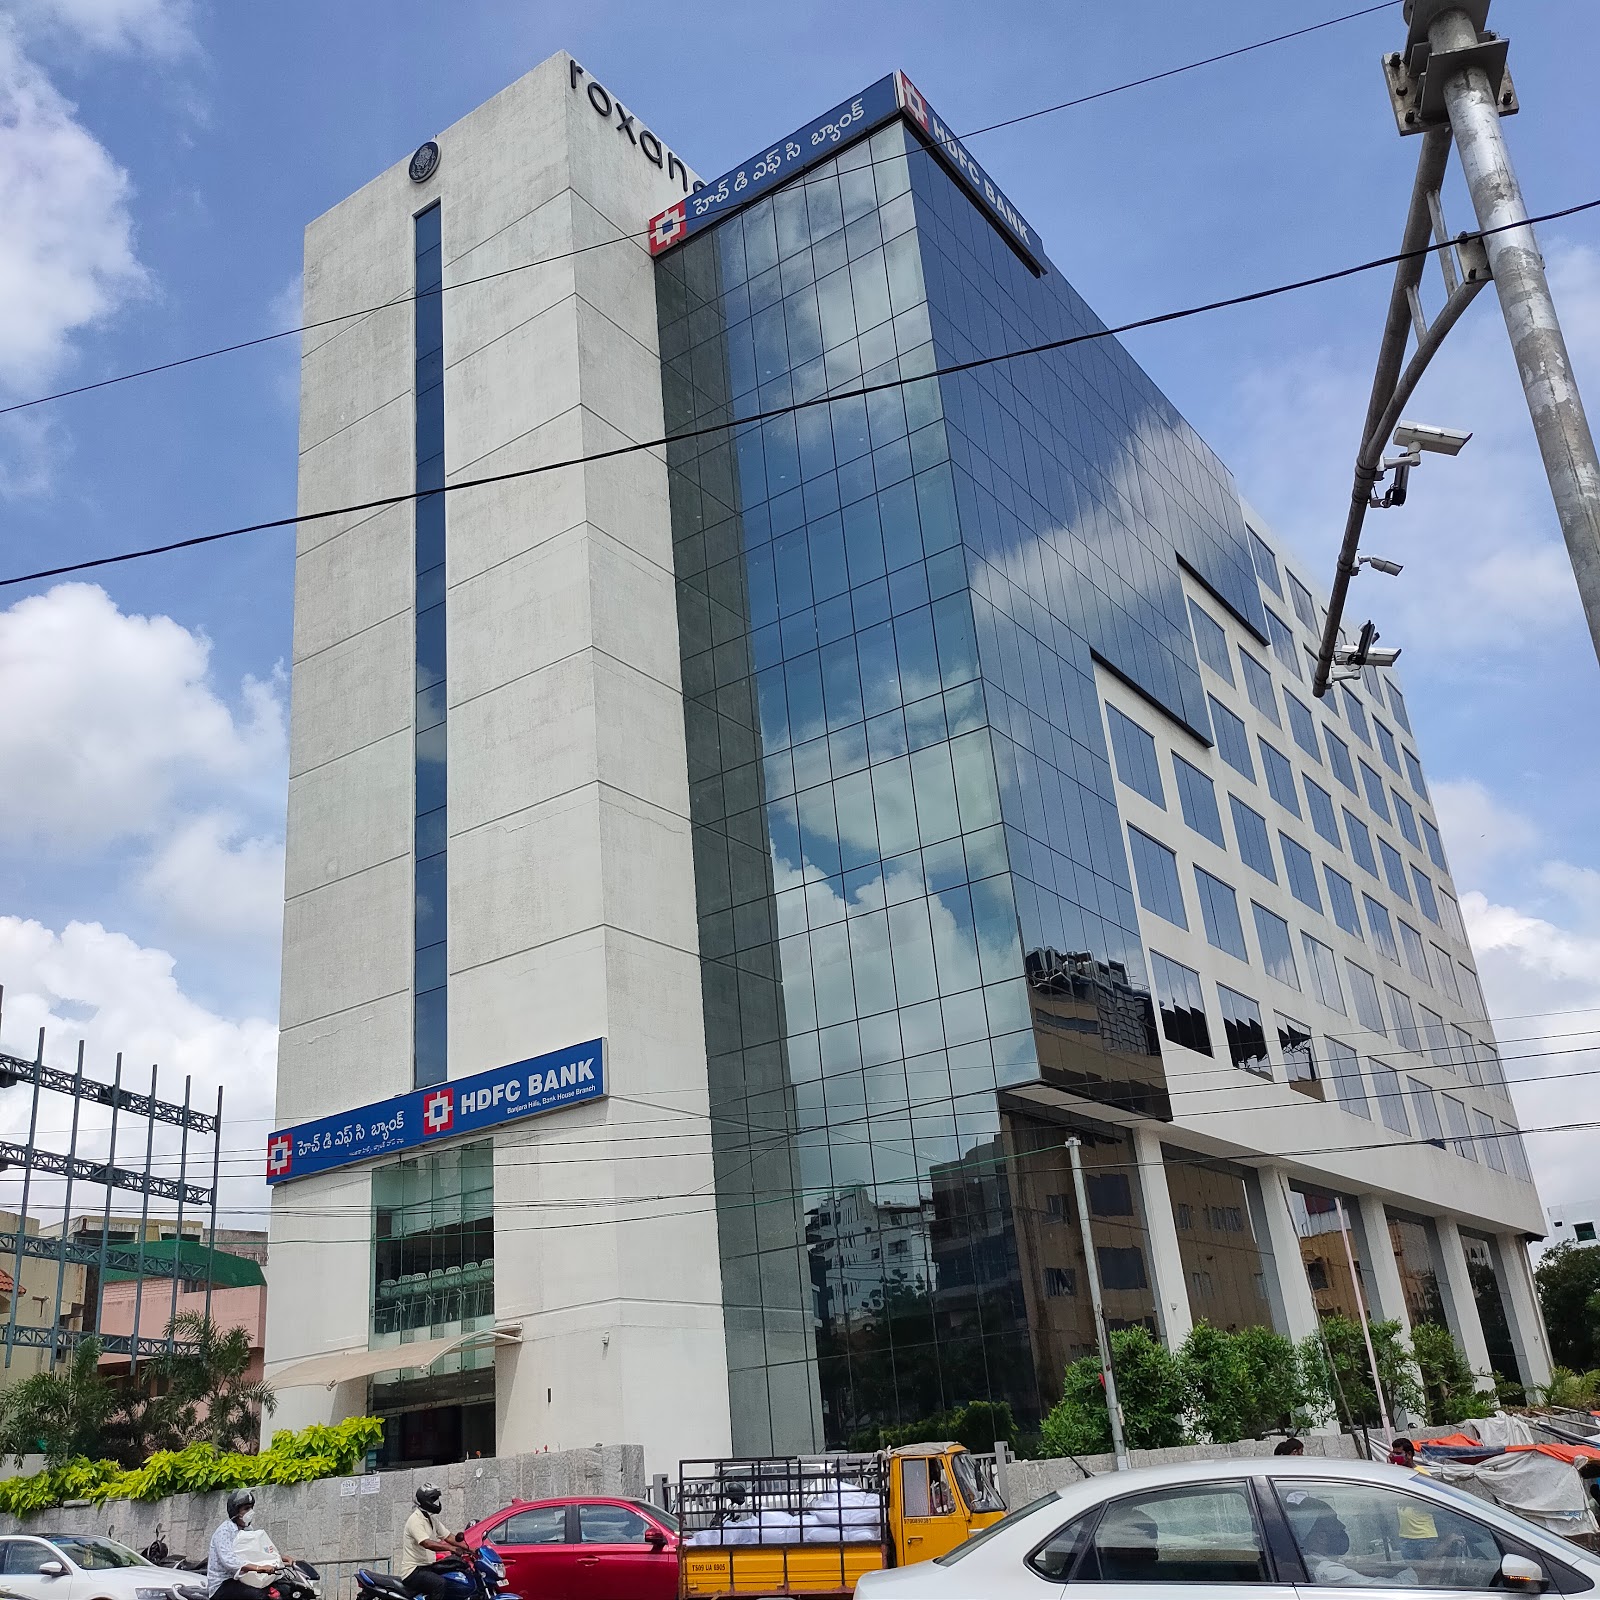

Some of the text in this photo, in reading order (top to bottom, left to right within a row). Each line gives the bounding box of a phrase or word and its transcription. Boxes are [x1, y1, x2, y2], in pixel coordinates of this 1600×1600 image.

[734, 171, 748, 192] డి
[785, 142, 801, 161] సి
[932, 116, 1031, 246] HDFC BANK
[460, 1057, 595, 1116] HDFC BANK
[507, 1104, 528, 1115] Banjara
[542, 1094, 557, 1105] Bank
[557, 1091, 575, 1101] House
[575, 1084, 596, 1096] Branch
[323, 1132, 332, 1150] డి
[355, 1123, 366, 1141] సి
